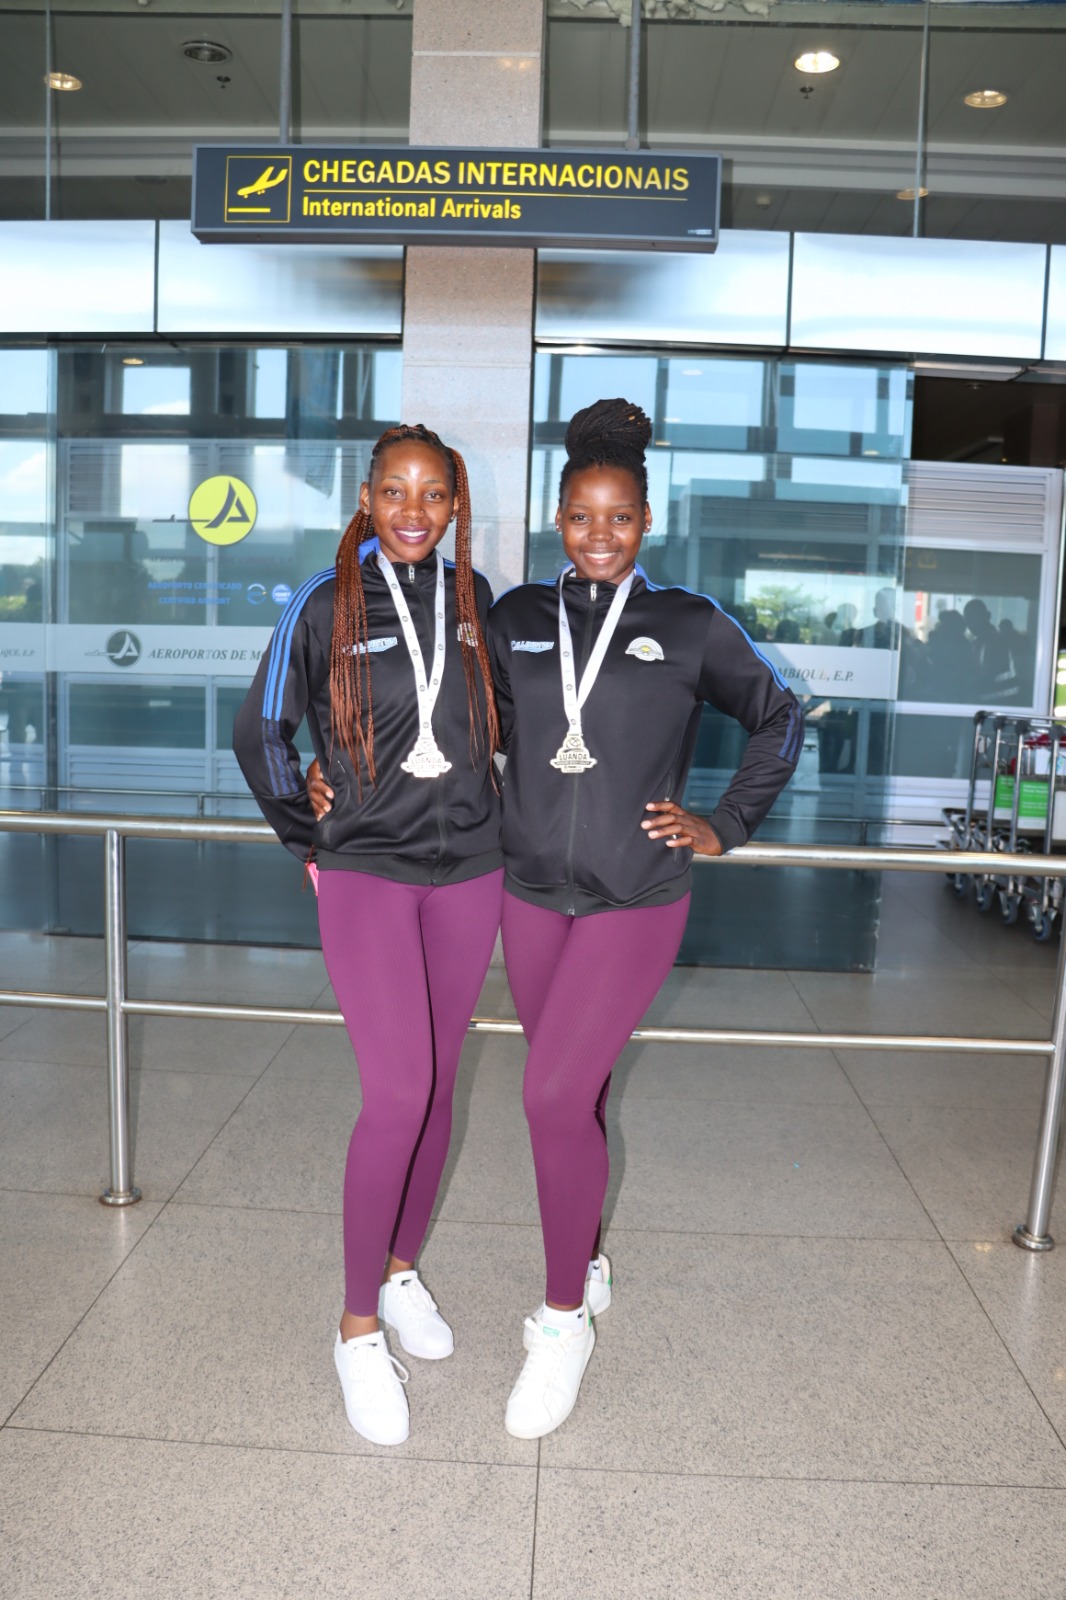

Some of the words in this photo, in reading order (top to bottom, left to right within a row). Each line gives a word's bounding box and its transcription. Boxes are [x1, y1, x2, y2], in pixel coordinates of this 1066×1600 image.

[303, 160, 451, 184] CHEGADAS
[458, 161, 690, 191] INTERNACIONAIS
[303, 196, 436, 217] International
[441, 197, 522, 219] Arrivals
[148, 648, 228, 660] AEROPORTOS
[230, 649, 248, 660] DE
[833, 670, 854, 682] E.P.
[559, 753, 588, 761] LUANDA
